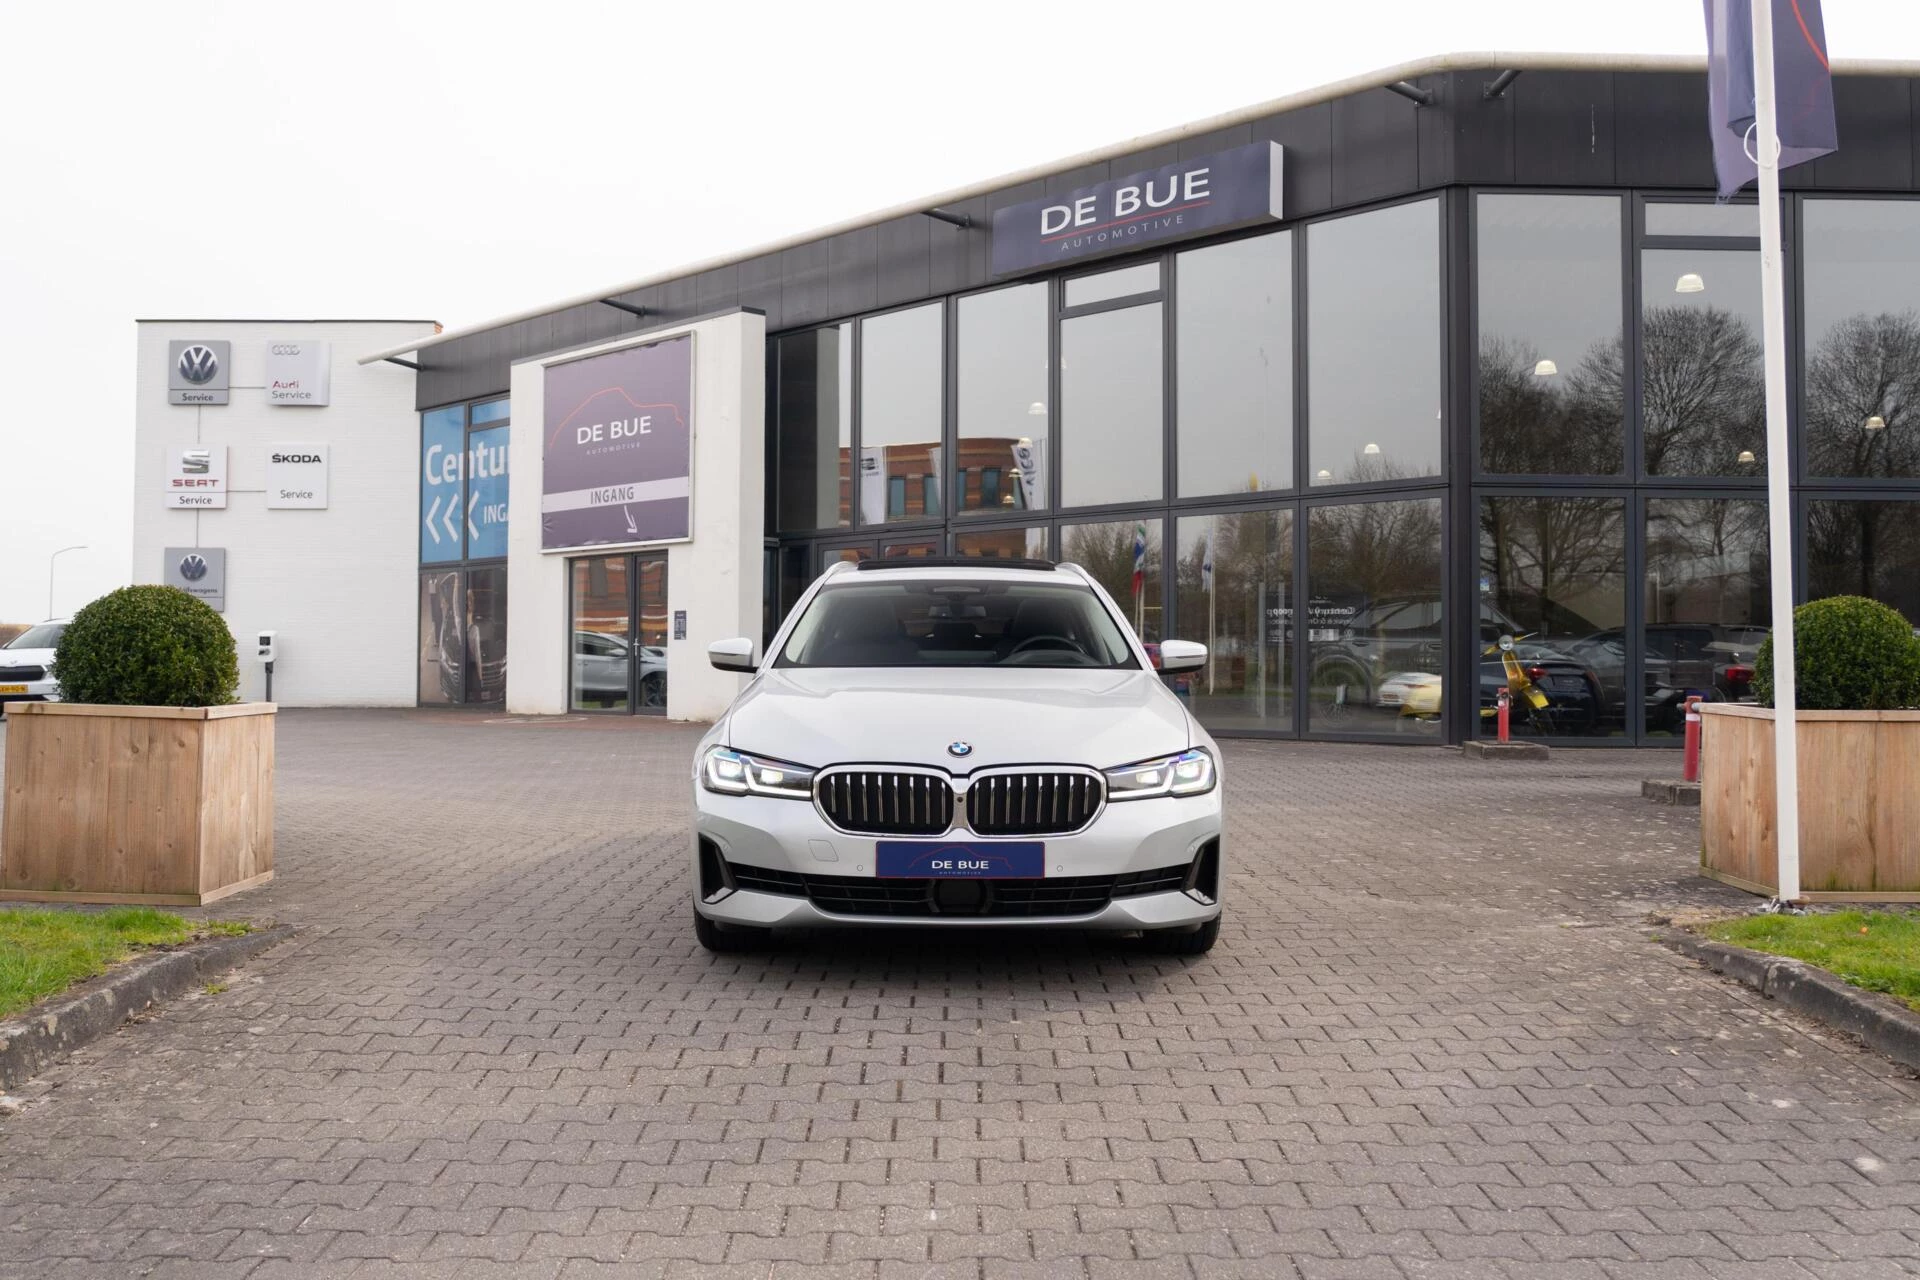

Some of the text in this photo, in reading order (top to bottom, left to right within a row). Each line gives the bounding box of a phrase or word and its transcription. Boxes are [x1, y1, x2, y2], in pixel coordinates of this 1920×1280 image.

[1041, 167, 1210, 235] DE BUE
[1061, 214, 1184, 251] AUTOMOTIVE
[272, 380, 300, 389] Audi
[181, 393, 214, 402] Service
[271, 390, 312, 399] Service
[577, 415, 652, 445] DE BUE
[271, 453, 322, 463] ŠKODA
[172, 479, 219, 487] SEAT
[280, 489, 313, 499] Service
[590, 486, 635, 505] INGANG
[179, 496, 213, 505] Service
[483, 503, 509, 524] ING
[931, 860, 989, 869] DE BUE
